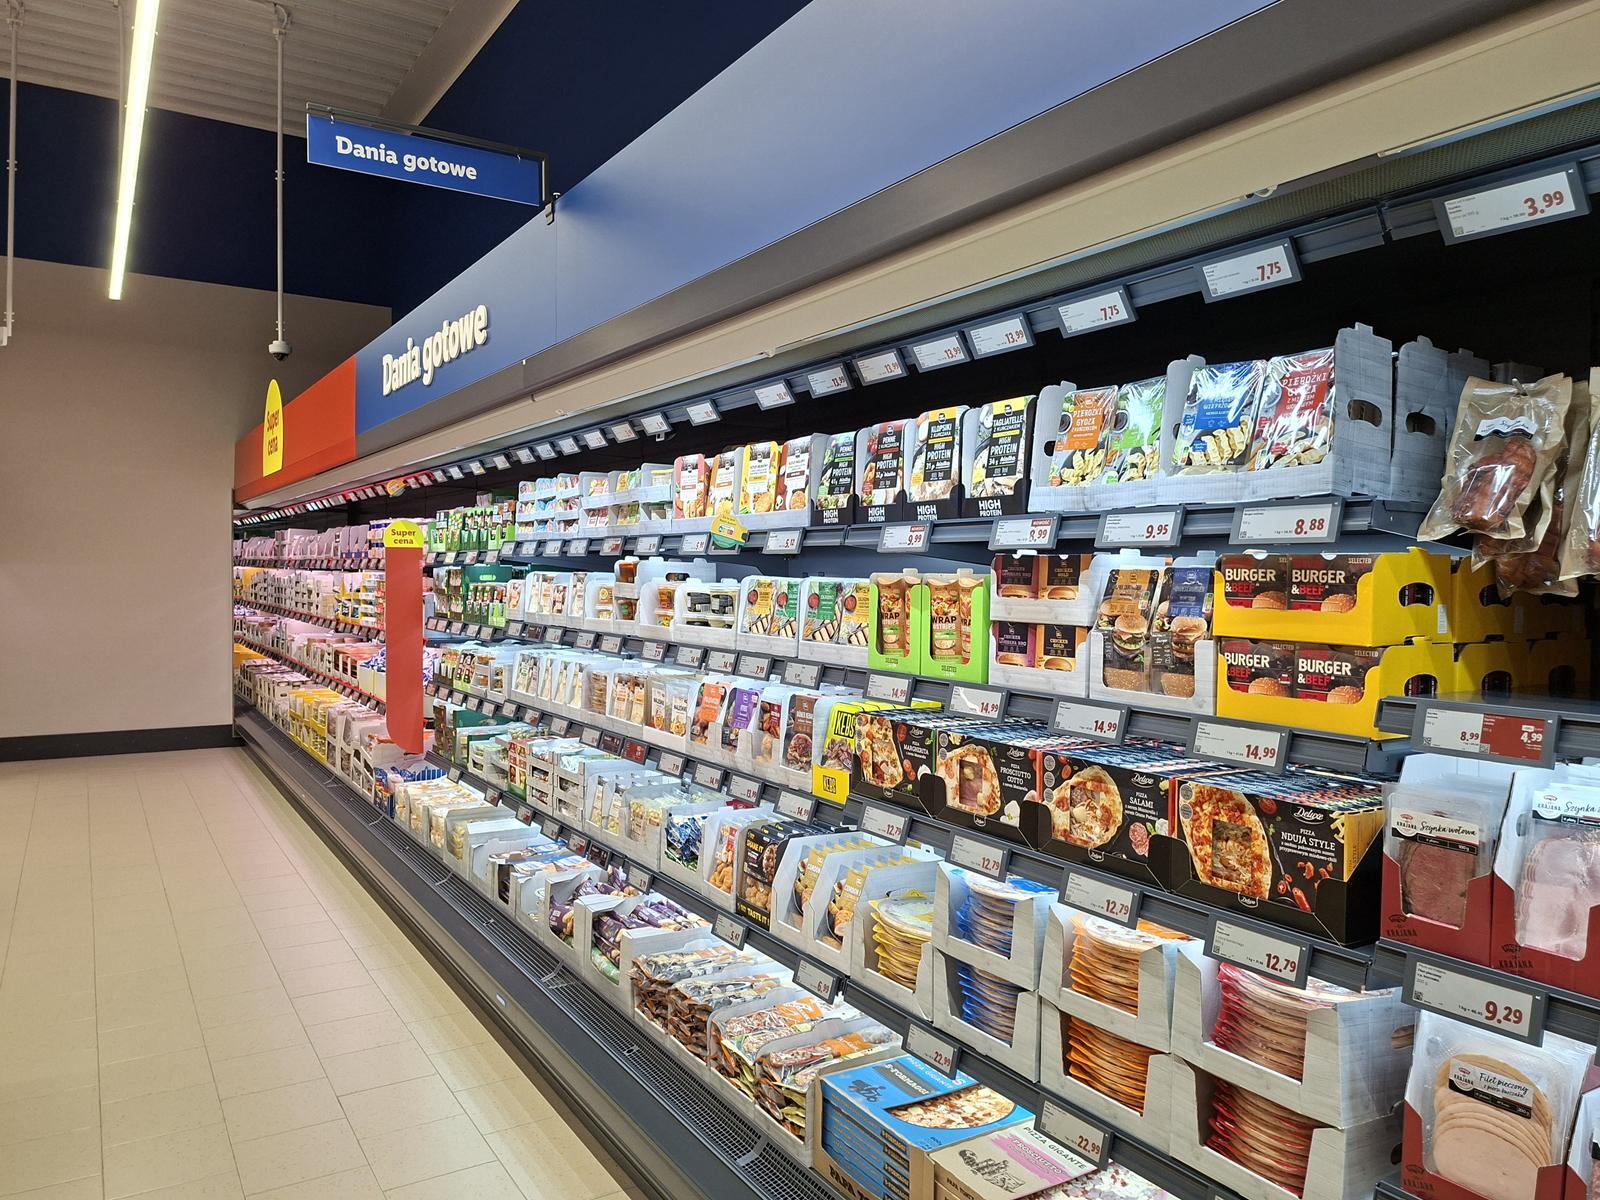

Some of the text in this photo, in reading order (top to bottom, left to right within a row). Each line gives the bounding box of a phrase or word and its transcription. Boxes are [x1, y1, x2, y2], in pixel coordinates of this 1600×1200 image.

[336, 135, 478, 180] Dania gotowe
[1523, 190, 1564, 217] 3.99
[1256, 261, 1282, 282] 7.75
[1100, 304, 1120, 321] 7.75
[1004, 329, 1024, 344] 13.99
[382, 304, 489, 396] Dania gotowe
[944, 346, 962, 360] 13.99
[1282, 372, 1326, 386] PIEROŻKI
[264, 409, 280, 435] Super
[993, 415, 1023, 426] TAGLIATELLE
[266, 434, 279, 456] cena
[990, 443, 1017, 456] PROTEIN
[927, 449, 951, 460] PROTEIN
[877, 460, 897, 469] PROTEIN
[833, 468, 852, 476] PROTEIN
[868, 507, 885, 515] HIGH
[917, 505, 937, 515] HIGH
[979, 500, 1001, 510] HIGH
[823, 509, 838, 518] HIGH
[391, 529, 417, 538] Super
[1145, 524, 1169, 539] 9.95
[1294, 518, 1325, 535] 8.88
[907, 534, 922, 546] 9.99
[1029, 529, 1048, 543] 8.99
[1225, 568, 1276, 582] BURGER
[1292, 570, 1345, 584] BURGER
[1224, 652, 1270, 668] BURGER
[1298, 658, 1352, 676] BURGER
[891, 687, 907, 698] 14.99
[979, 701, 999, 714] 14.99
[1093, 720, 1117, 734] 14.99
[1460, 731, 1479, 742] 8.99
[1521, 732, 1543, 743] 4.99
[1007, 747, 1024, 757] Deluxe
[1246, 744, 1276, 760] 14.99
[1000, 767, 1031, 779] PROSCIUTTO
[1007, 776, 1024, 784] COTTO
[1131, 773, 1154, 784] Deluxe
[1130, 797, 1153, 808] SALAMI
[1564, 801, 1595, 815] Szynka
[1294, 807, 1324, 820] Deluxe
[886, 824, 901, 835] 12.79
[1420, 821, 1446, 834] Szynka
[1448, 826, 1476, 836] wołowa
[1281, 832, 1307, 845] NDUJA
[1309, 838, 1336, 851] STYLE
[981, 856, 1000, 871] 12.79
[1105, 899, 1130, 916] 12.79
[1241, 897, 1256, 905] Deluxe
[747, 908, 761, 921] TASTE
[1386, 928, 1417, 937] KRAJANA
[1265, 952, 1296, 973] 12.79
[1500, 960, 1533, 969] KRAJANA
[817, 980, 829, 994] 6.99
[1484, 1000, 1523, 1024] 9.29
[934, 1050, 951, 1067] 22.99
[1454, 1073, 1528, 1095] KRAJANA Filet pieczony
[1024, 1126, 1087, 1170] PIZZA GIGANTE
[1077, 1135, 1100, 1155] 22.99
